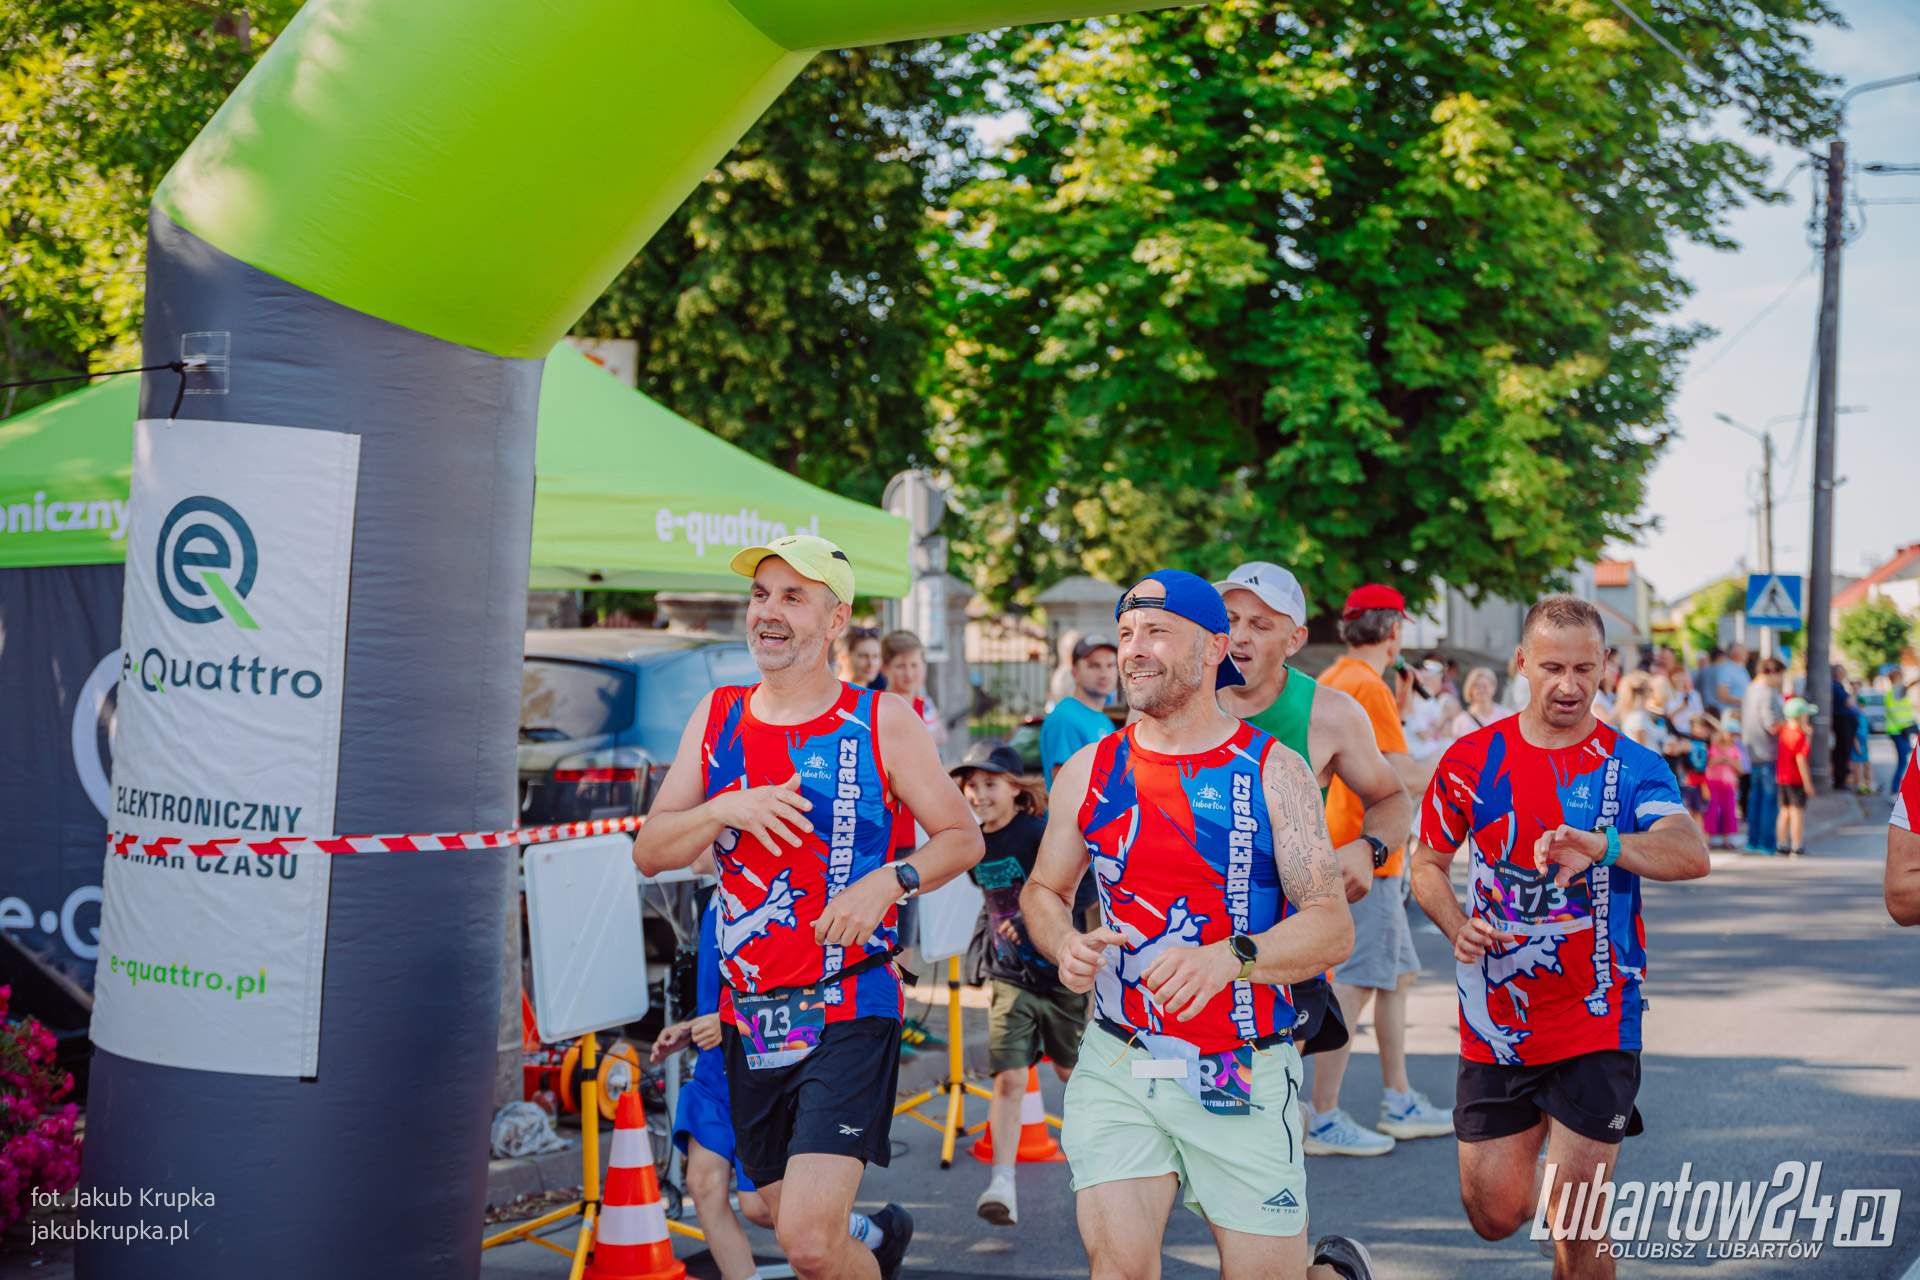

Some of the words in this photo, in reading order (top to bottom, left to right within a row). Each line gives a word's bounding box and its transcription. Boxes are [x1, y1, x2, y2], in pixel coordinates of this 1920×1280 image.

[117, 786, 302, 833] ELEKTRONICZNY
[1510, 882, 1568, 913] 173
[111, 955, 266, 1000] e-quattro.pl
[757, 1005, 791, 1038] 23
